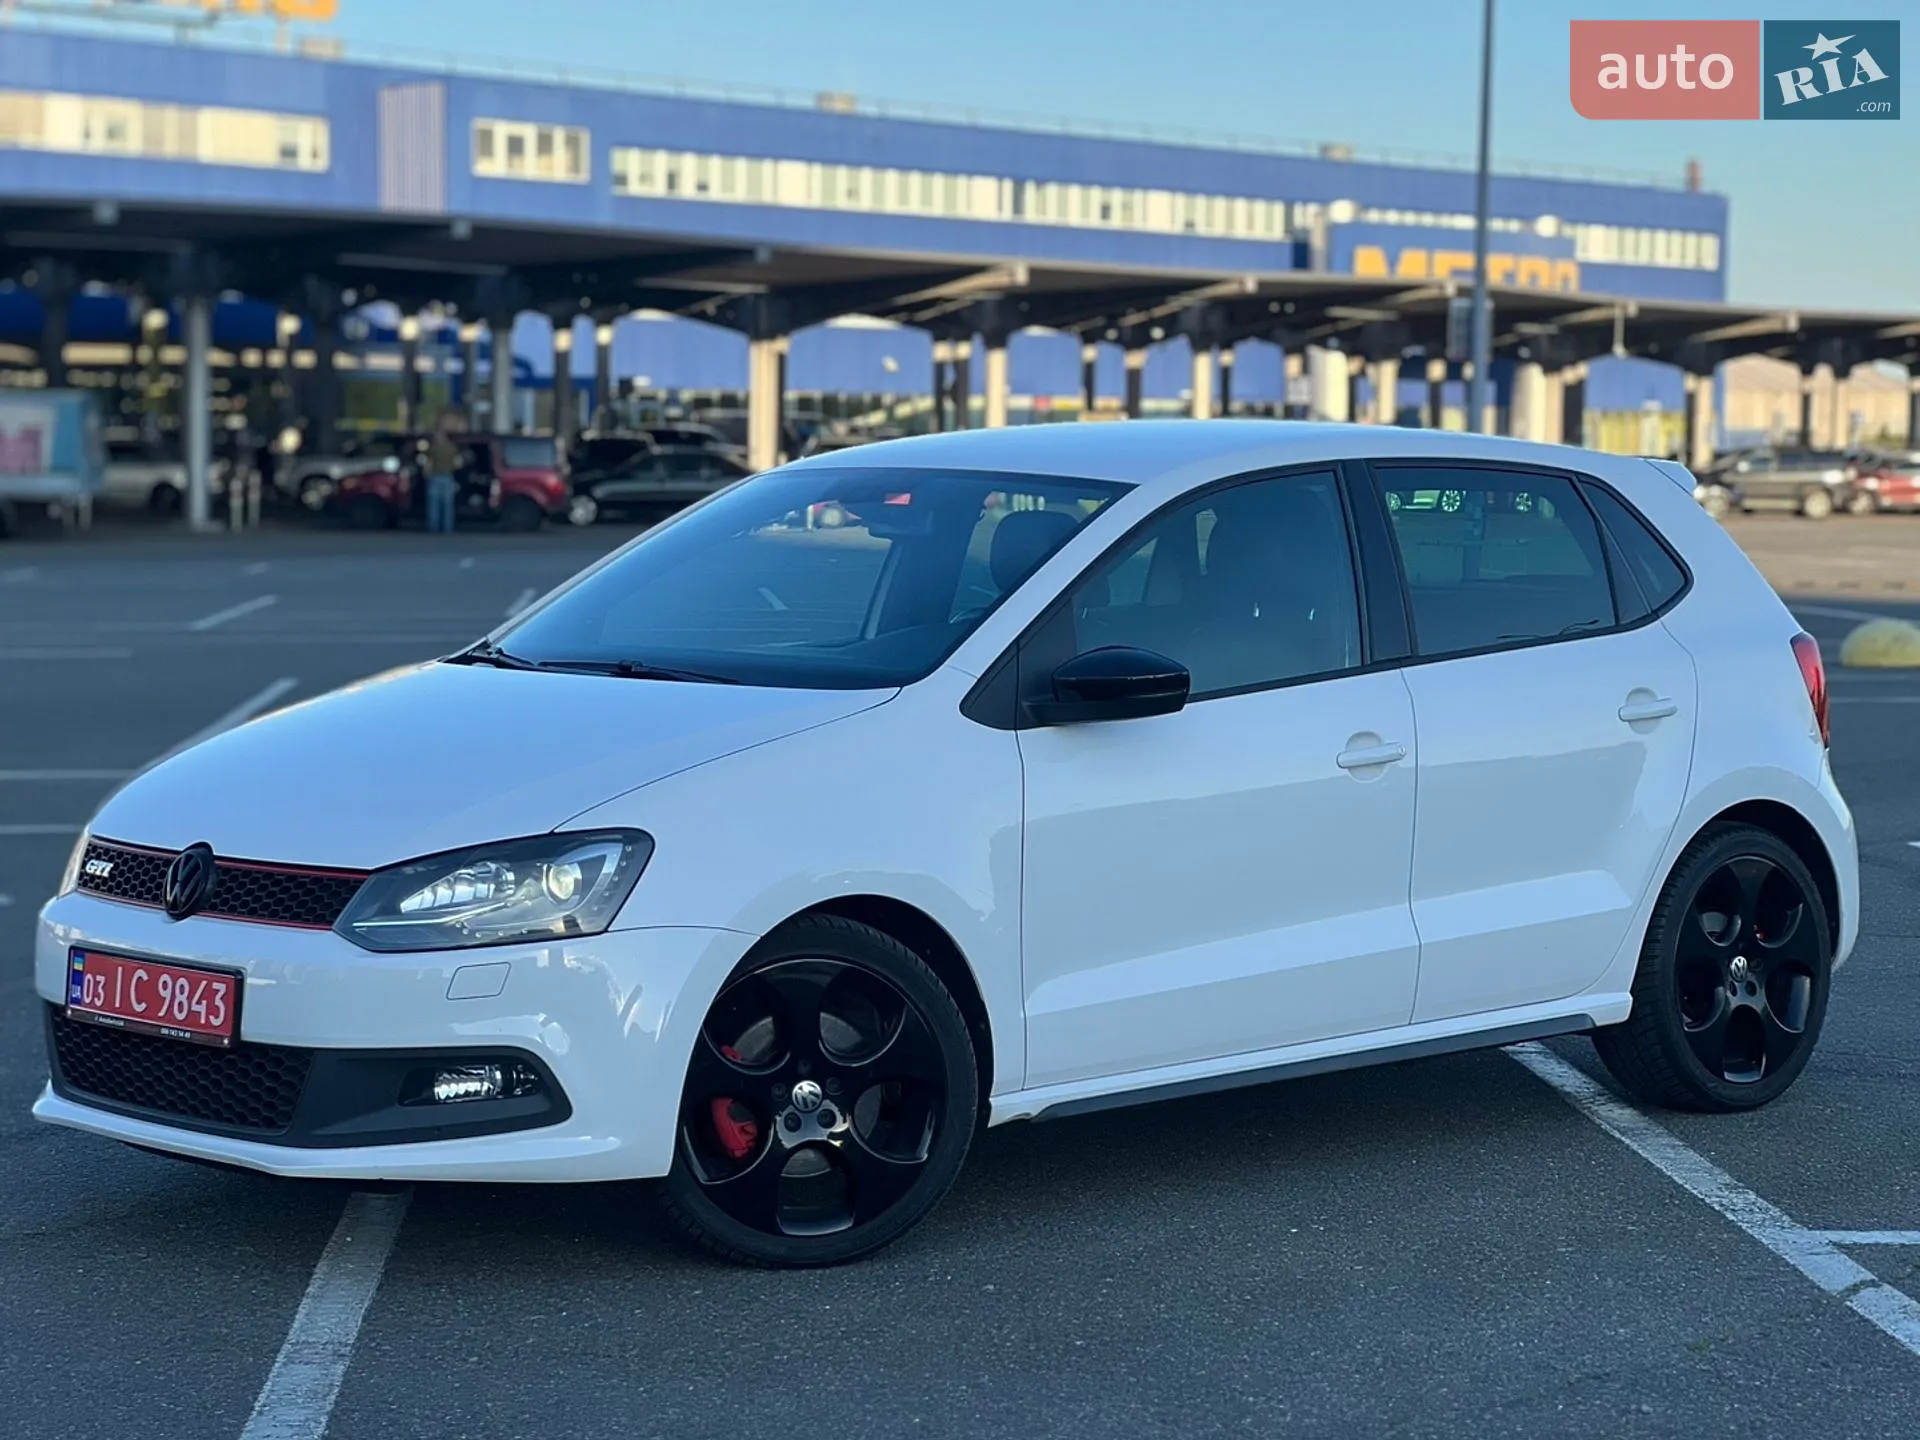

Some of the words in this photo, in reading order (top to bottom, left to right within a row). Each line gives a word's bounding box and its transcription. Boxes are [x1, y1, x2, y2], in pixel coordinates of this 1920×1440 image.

[85, 859, 114, 877] GTI
[83, 973, 106, 1007] 03
[115, 966, 149, 1012] IC
[157, 973, 227, 1027] 9843
